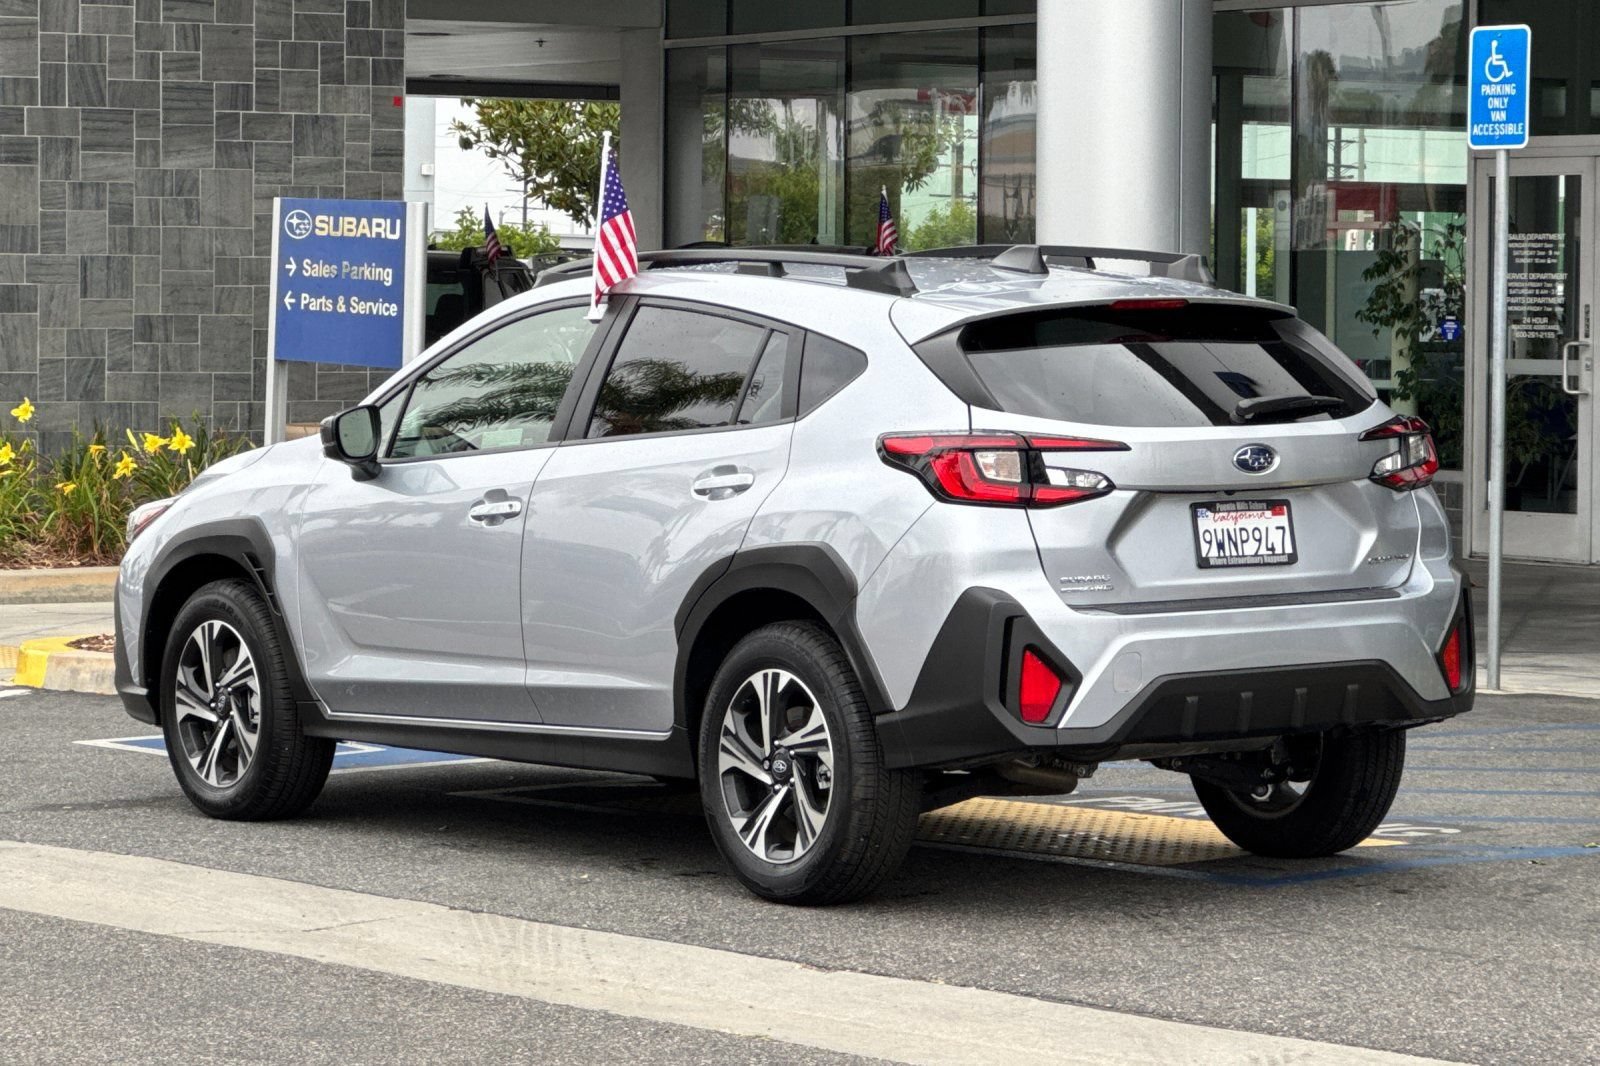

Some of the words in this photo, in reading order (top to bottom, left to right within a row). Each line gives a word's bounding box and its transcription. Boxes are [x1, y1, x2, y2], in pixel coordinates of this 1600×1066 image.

[1481, 83, 1516, 96] PARKING
[1488, 97, 1509, 109] ONLY
[1491, 110, 1506, 122] VAN
[1473, 123, 1524, 136] ACCESSIBLE
[315, 215, 400, 240] SUBARU
[302, 258, 338, 278] Sales
[342, 261, 393, 286] Parking
[301, 293, 332, 312] Parts
[337, 295, 346, 313] &
[350, 297, 398, 316] Service
[1196, 509, 1209, 518] DEC
[1212, 511, 1271, 526] California
[1202, 526, 1286, 557] 9WNP947
